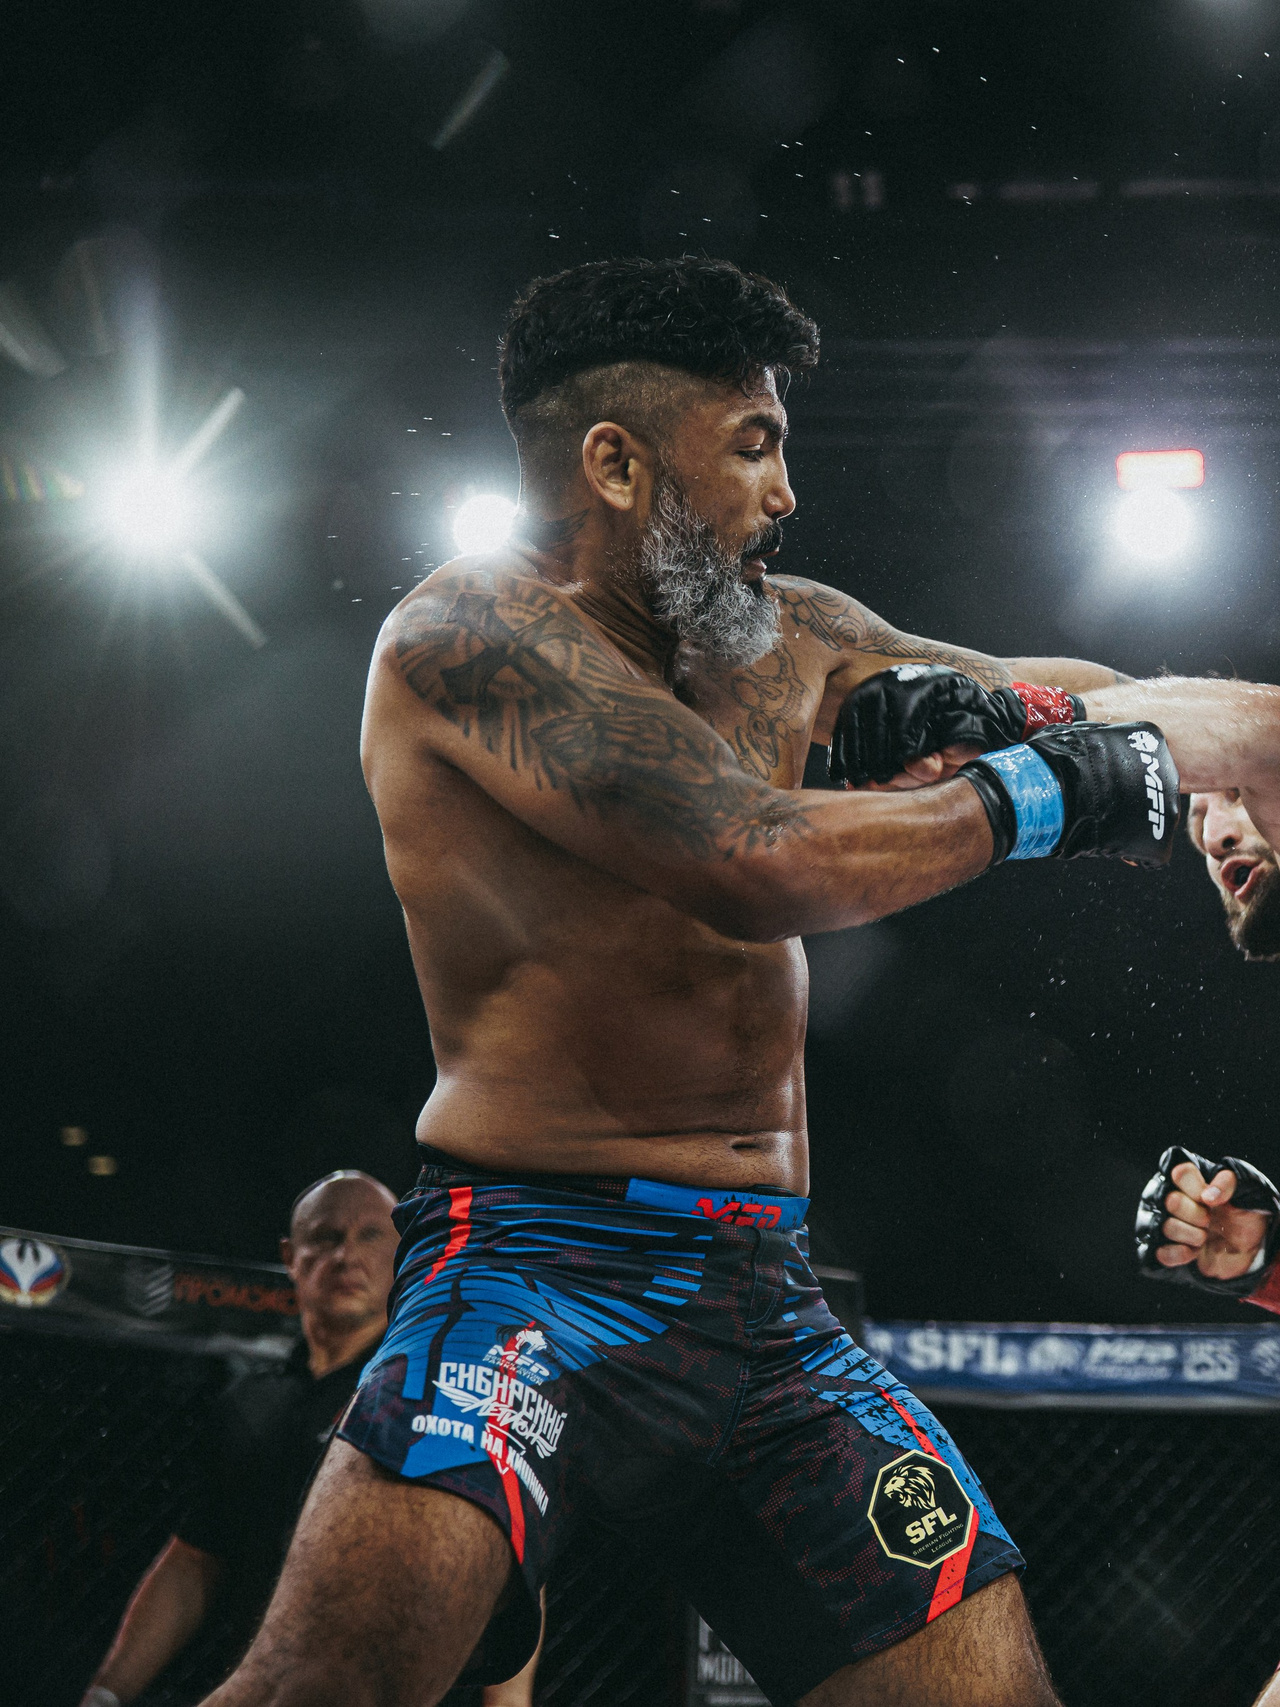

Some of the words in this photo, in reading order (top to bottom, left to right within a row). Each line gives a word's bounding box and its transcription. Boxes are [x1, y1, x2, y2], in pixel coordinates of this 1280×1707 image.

[1140, 752, 1165, 840] MFP
[488, 1344, 550, 1377] MFP
[411, 1415, 474, 1443] ОХОТА
[481, 1431, 503, 1459] НА
[905, 1506, 958, 1544] SFL
[912, 1538, 938, 1556] SIBERIAN
[938, 1523, 964, 1541] FIGHTING
[931, 1537, 953, 1553] LEAGUE
